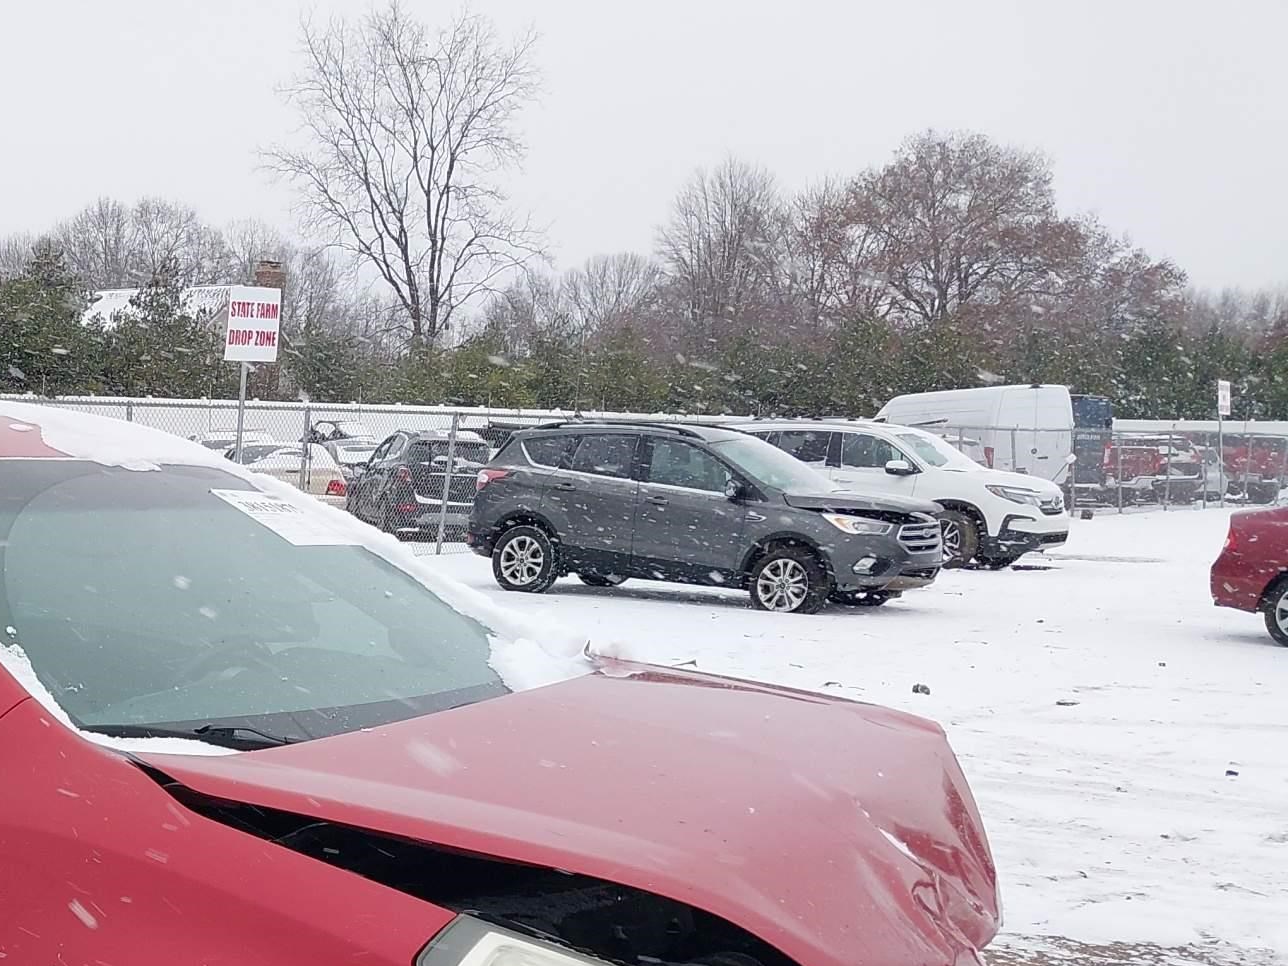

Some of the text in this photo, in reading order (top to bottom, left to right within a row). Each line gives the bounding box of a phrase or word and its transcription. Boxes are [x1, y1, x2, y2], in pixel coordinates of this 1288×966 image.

[231, 301, 278, 319] STATE FARM
[228, 329, 277, 347] DROP ZONE
